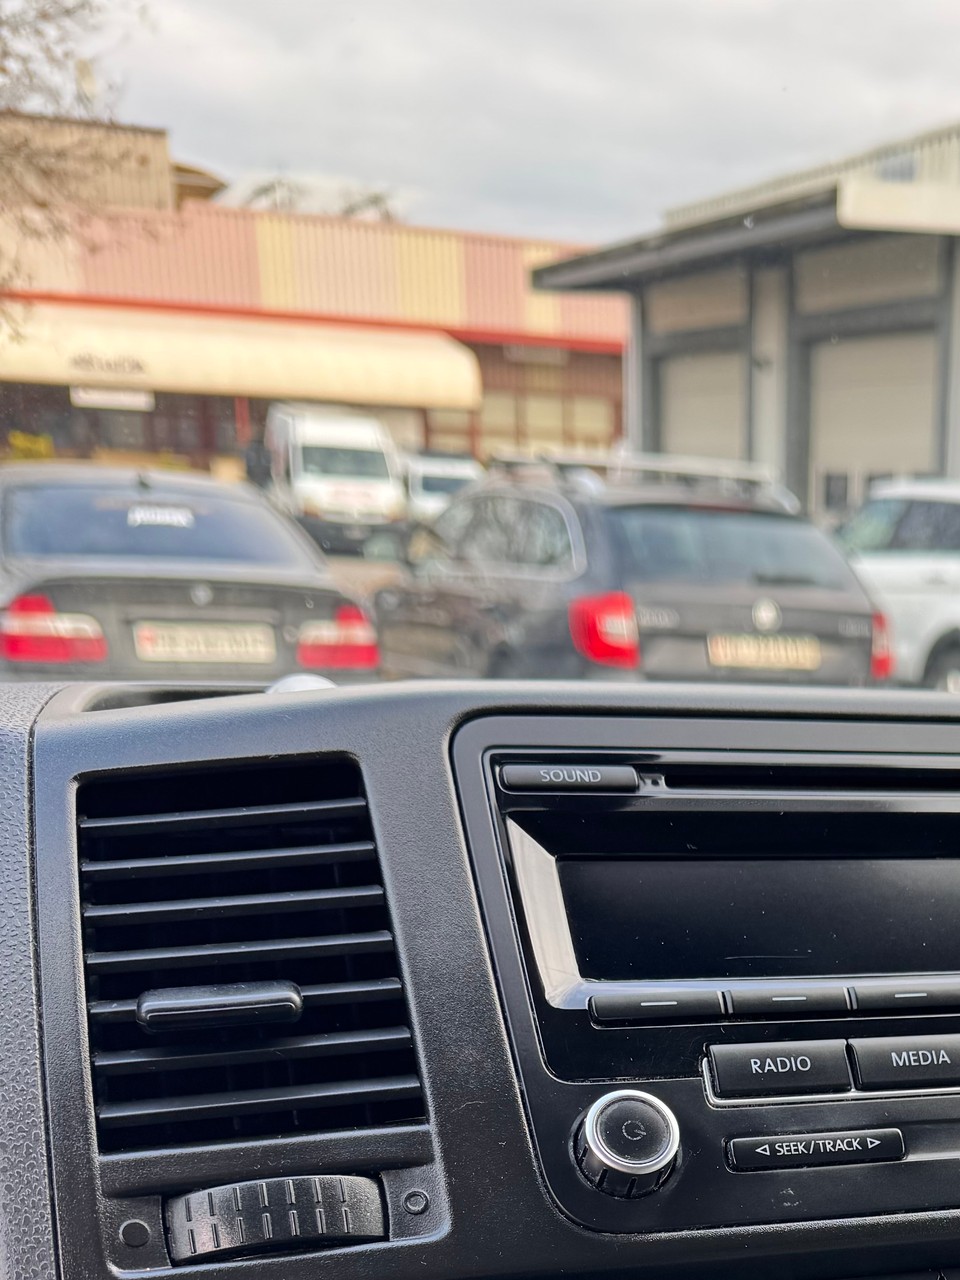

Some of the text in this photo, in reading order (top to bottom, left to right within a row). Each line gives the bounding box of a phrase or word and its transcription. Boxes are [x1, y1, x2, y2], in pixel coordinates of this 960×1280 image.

[540, 769, 601, 783] SOUND
[750, 1056, 812, 1074] RADIO
[891, 1049, 951, 1068] MEDIA
